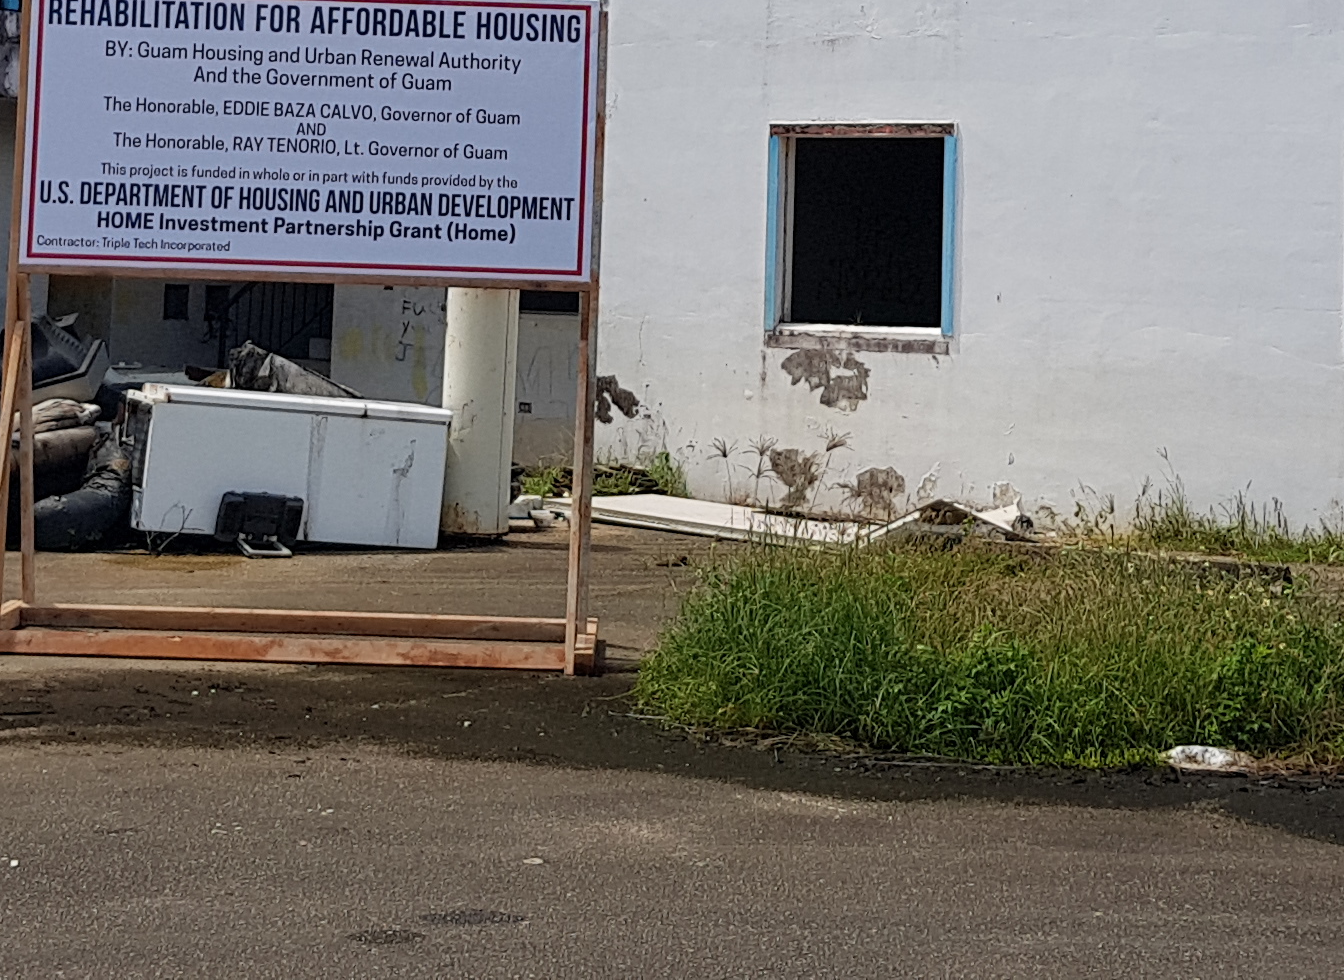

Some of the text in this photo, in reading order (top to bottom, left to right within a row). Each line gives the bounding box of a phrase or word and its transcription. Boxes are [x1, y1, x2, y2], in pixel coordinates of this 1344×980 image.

[255, 3, 301, 34] FOR
[309, 5, 467, 40] AFFORDABLE
[476, 11, 581, 44] HOUSING
[105, 39, 522, 75] BY: Guam Housing and Urban Renewal Authority
[193, 65, 452, 92] And the Government of Guam
[103, 95, 521, 126] The Honorable, EDDIE BAZA CALVO, Governor of Guam
[295, 122, 327, 137] AND
[112, 131, 508, 161] The Honorable, RAY TENORIO, Lt. Governor of Guam
[100, 162, 518, 191] This project is funded in whole or in part with funds provided by the
[39, 179, 576, 222] U.S. DEPARTMENT OF HOUSING AND URBAN DEVELOPMENT
[96, 210, 516, 245] HOME Investment Partnership Grant (Home)
[36, 234, 231, 253] Contractor: Triple Tech Incorporated
